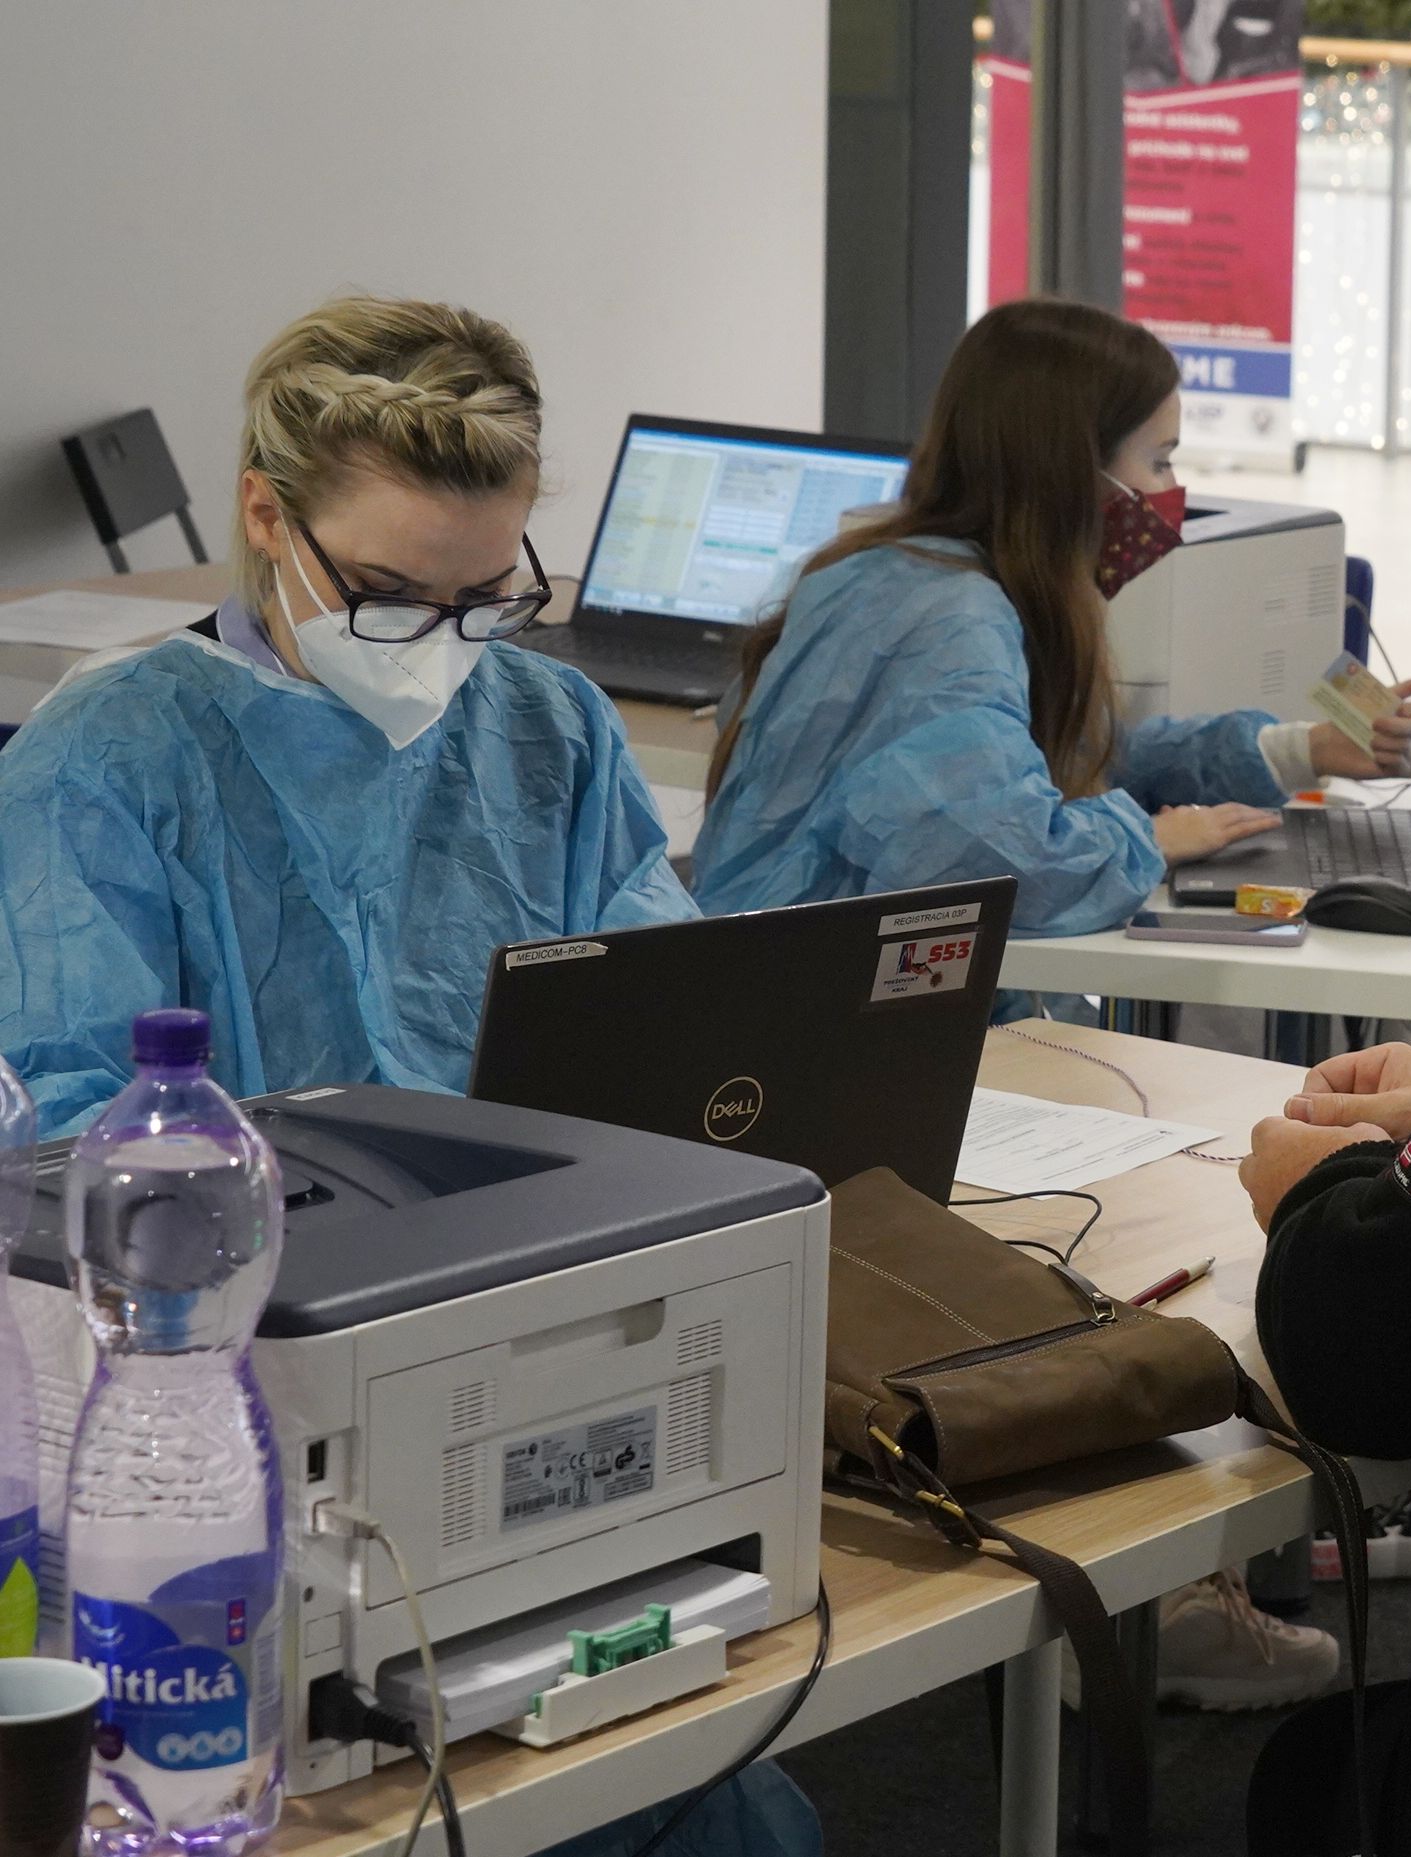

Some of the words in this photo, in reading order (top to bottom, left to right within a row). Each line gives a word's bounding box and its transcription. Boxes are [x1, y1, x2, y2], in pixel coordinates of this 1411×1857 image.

[1174, 353, 1236, 389] ME
[893, 911, 950, 926] REGISTRACIA
[516, 944, 588, 962] MEDICOM-PC8
[927, 940, 972, 964] S53
[712, 1098, 756, 1120] DELL
